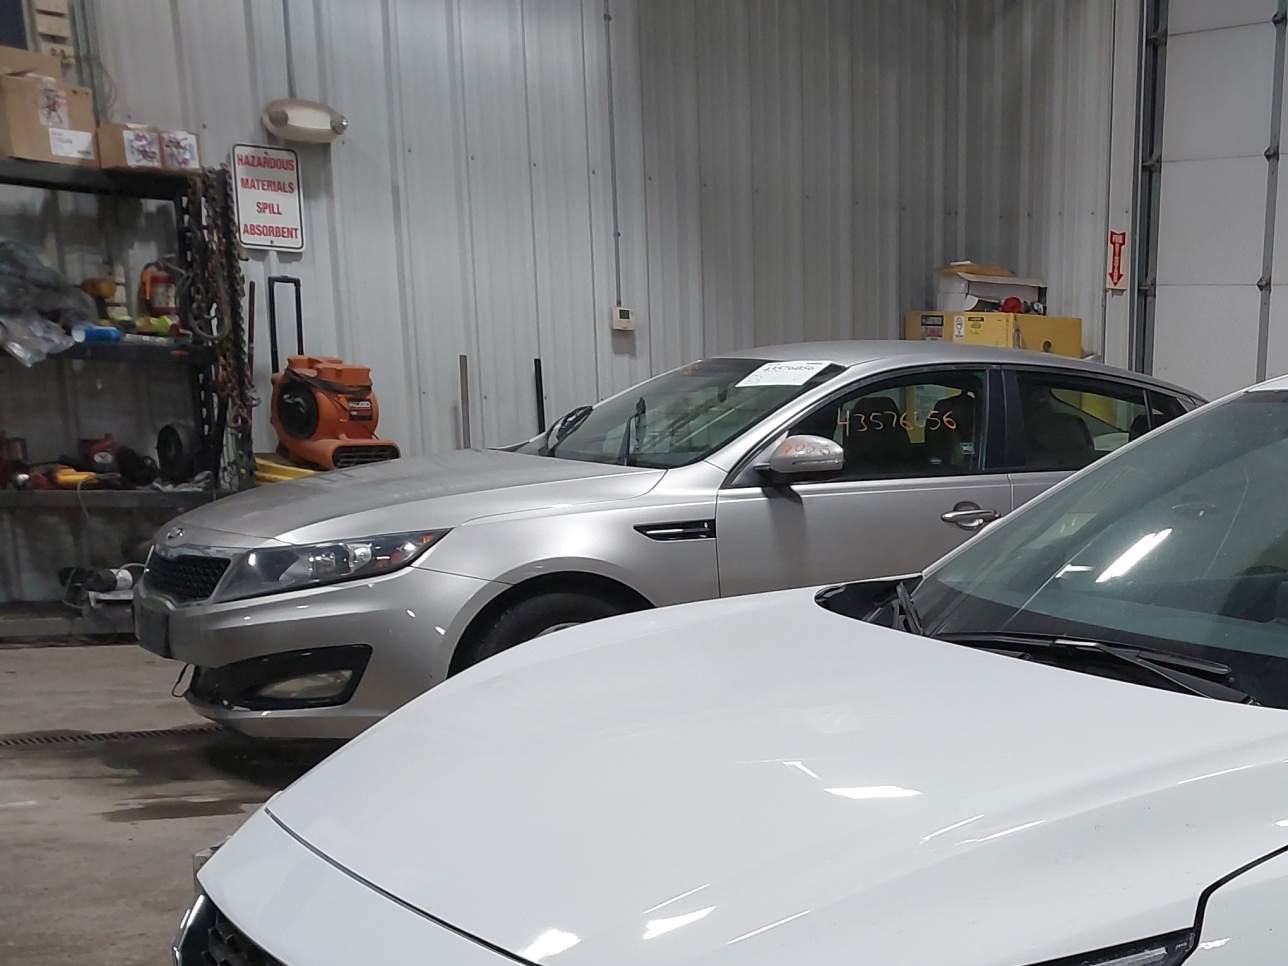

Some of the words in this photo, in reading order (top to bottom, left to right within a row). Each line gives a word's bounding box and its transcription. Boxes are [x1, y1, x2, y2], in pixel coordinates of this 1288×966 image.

[237, 154, 295, 171] HAZARDOUS
[240, 178, 295, 194] MATERIALS
[256, 201, 282, 216] SPILL
[243, 223, 299, 239] ABSORBENT
